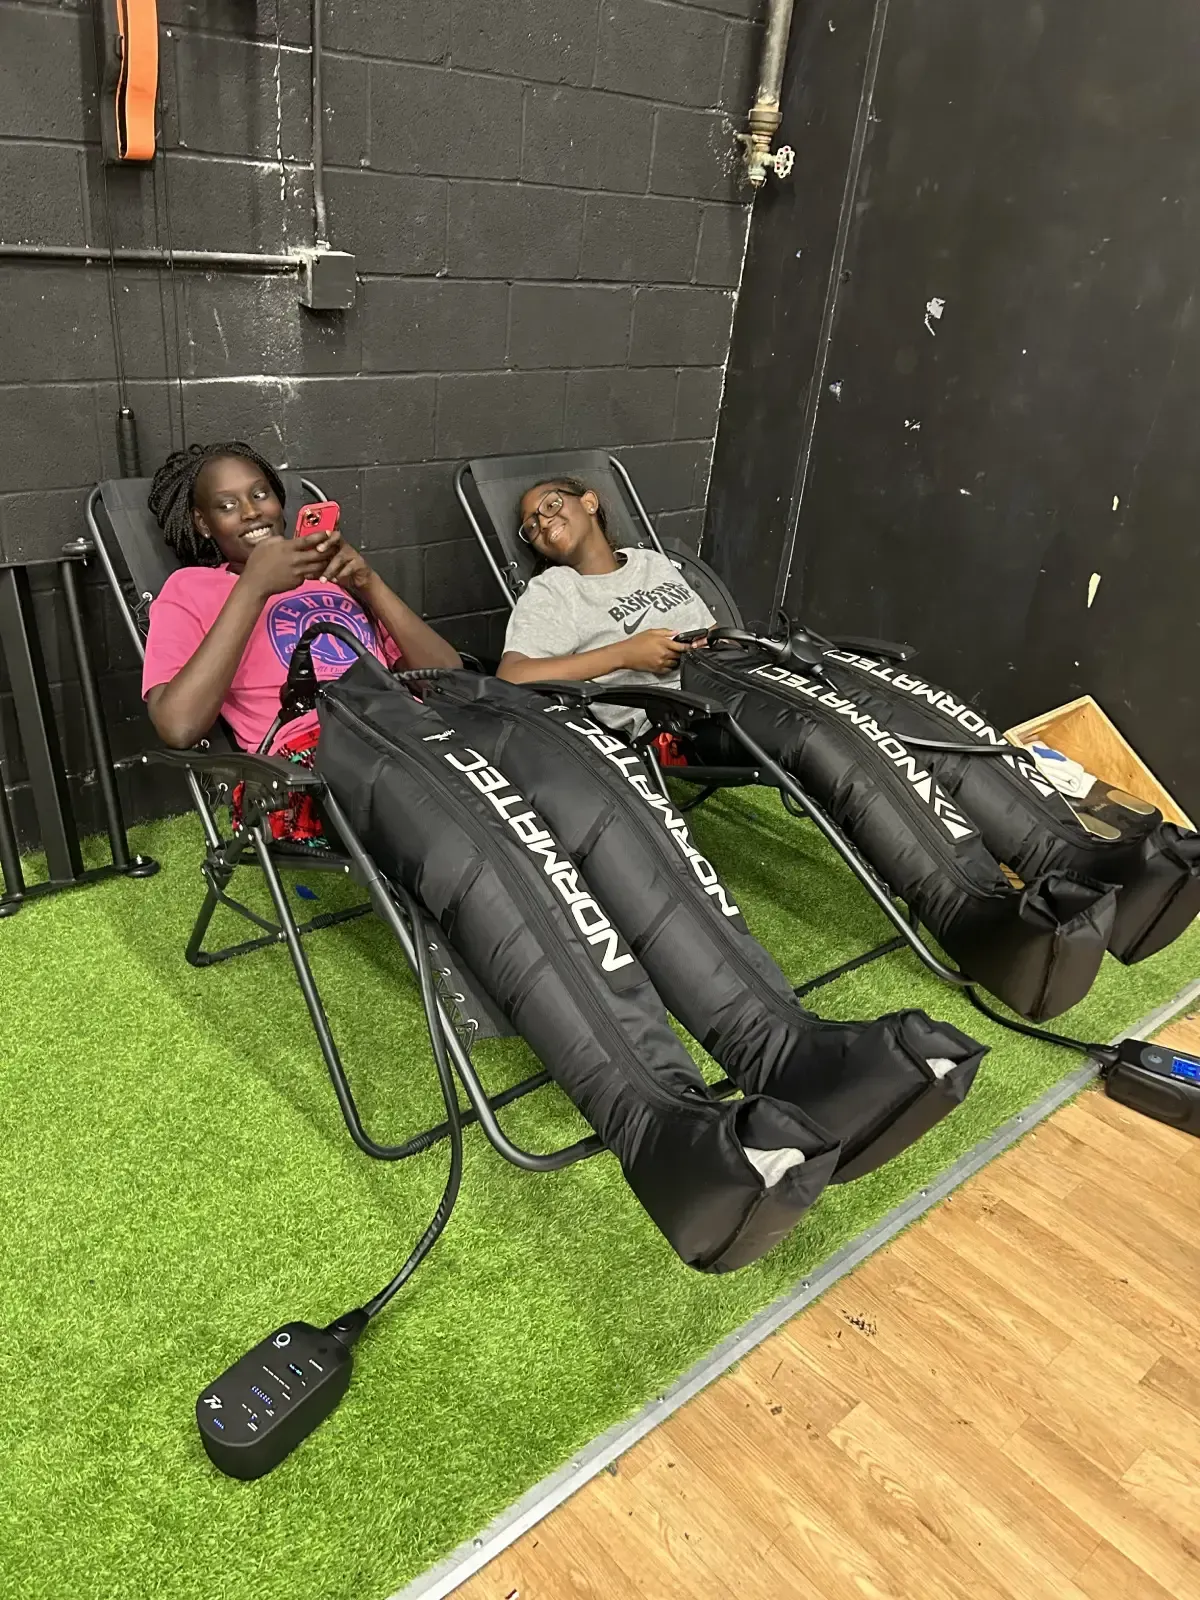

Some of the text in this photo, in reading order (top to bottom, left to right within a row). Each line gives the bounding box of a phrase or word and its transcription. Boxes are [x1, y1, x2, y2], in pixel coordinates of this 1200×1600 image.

[274, 595, 369, 637] WE HOOP
[653, 586, 692, 613] CAMP
[757, 666, 929, 783] NORMATEC
[827, 651, 1008, 746] NORMATEC
[443, 747, 635, 973] NORMATEC
[564, 717, 740, 917] NORMATEC
